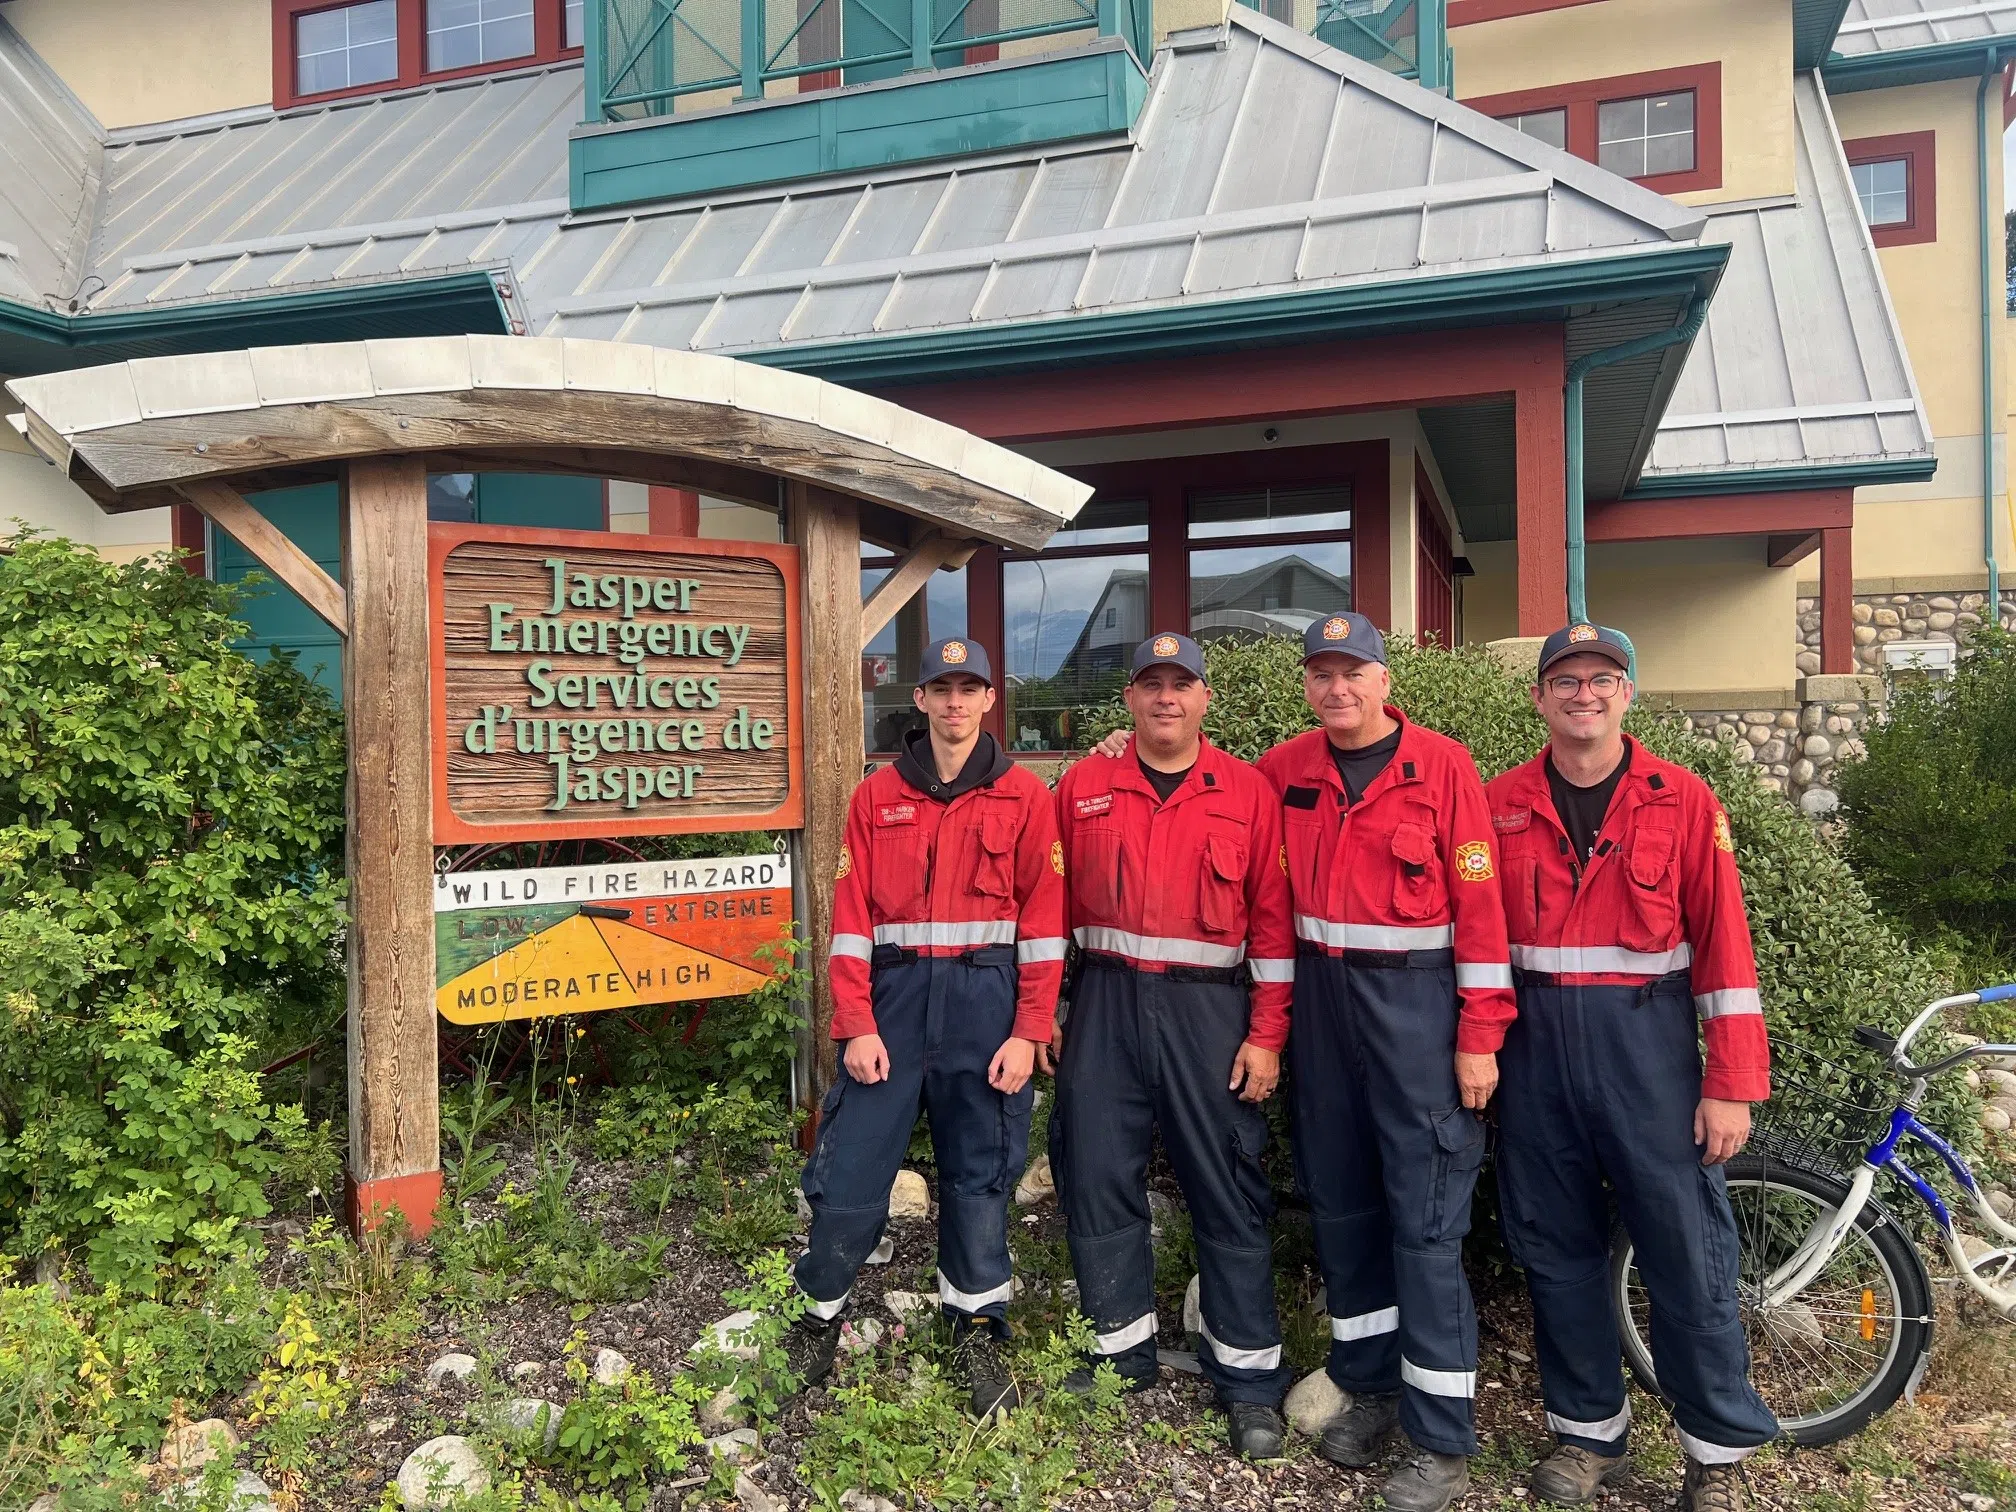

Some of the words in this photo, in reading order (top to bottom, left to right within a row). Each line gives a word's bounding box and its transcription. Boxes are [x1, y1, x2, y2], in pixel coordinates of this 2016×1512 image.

[542, 558, 700, 618] Jasper
[488, 603, 750, 666] Emergency
[527, 660, 720, 709] Services
[464, 704, 705, 763] d'urgence
[723, 706, 774, 751] de
[544, 754, 703, 811] Jasper
[883, 812, 913, 822] FIREFIGHTER
[452, 877, 538, 904] WILD
[564, 872, 638, 896] FIRE
[663, 863, 775, 889] HAZARD
[456, 916, 528, 941] LOW
[645, 896, 774, 926] EXTREME
[457, 972, 621, 1010] MODERATE
[636, 962, 712, 989] HIGH
